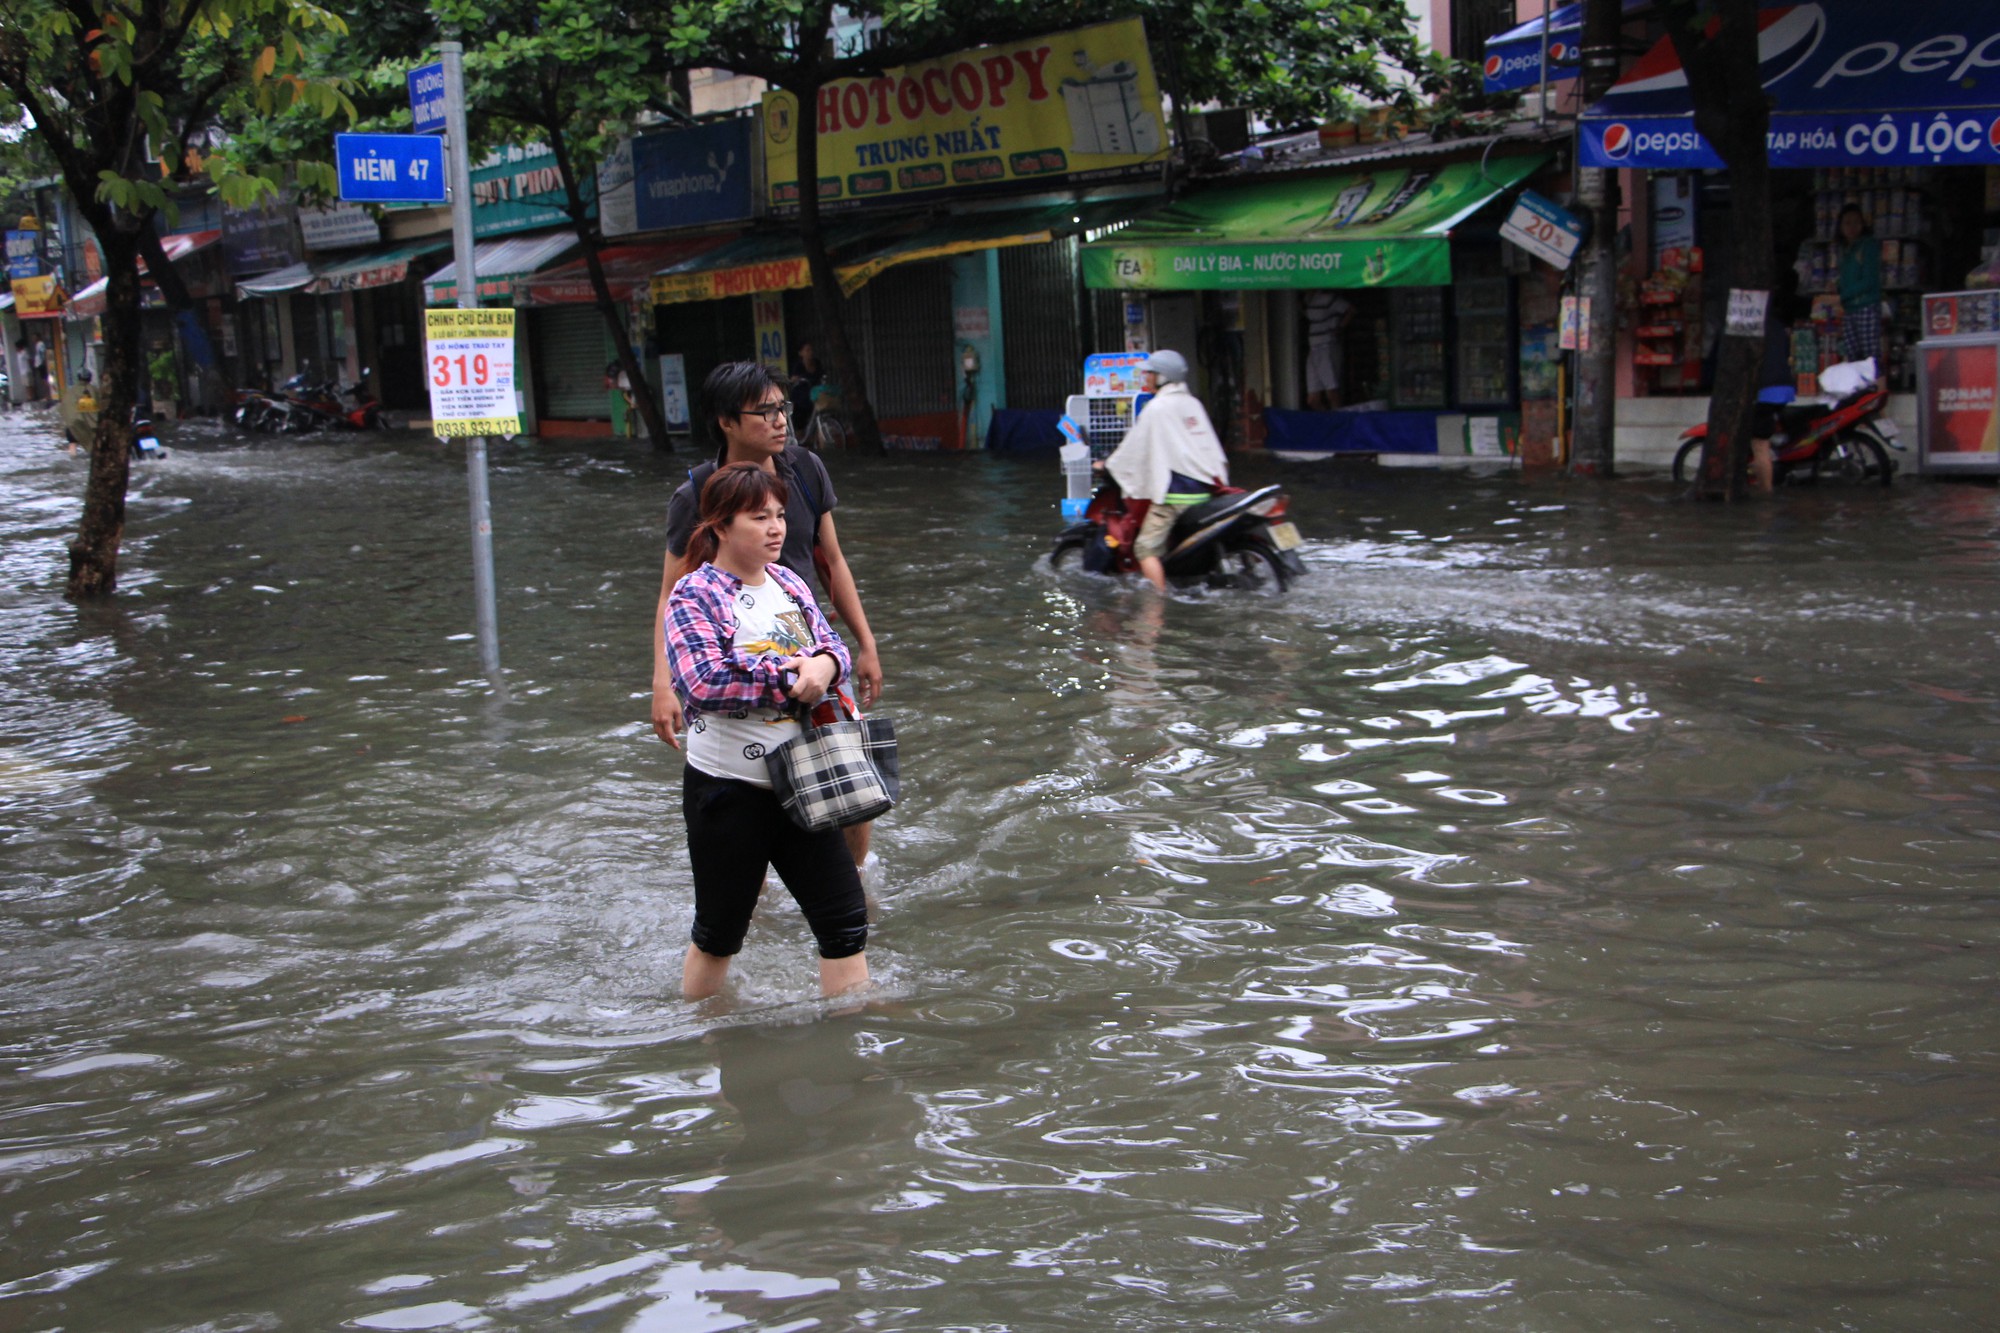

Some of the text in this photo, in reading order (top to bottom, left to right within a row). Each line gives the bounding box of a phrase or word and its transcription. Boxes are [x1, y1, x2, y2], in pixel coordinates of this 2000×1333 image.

[817, 46, 1051, 134] HOTOCOPY
[855, 115, 1002, 167] TRUNG NHẤT
[1634, 132, 1700, 156] pepsi
[1799, 127, 1837, 149] HÓA
[1845, 114, 1898, 155] CÔ
[1909, 111, 1981, 162] LỘC
[353, 149, 429, 181] HẺM 47
[650, 173, 715, 200] vinaphone
[713, 259, 801, 295] PHOTOCOPY
[1174, 256, 1196, 277] ĐẠI
[1218, 255, 1242, 271] BIA
[1253, 251, 1296, 271] NƯỚC
[1300, 253, 1343, 273] NGỌT
[757, 302, 780, 324] IN
[433, 354, 489, 387] 319
[436, 419, 517, 437] 0938.932.127
